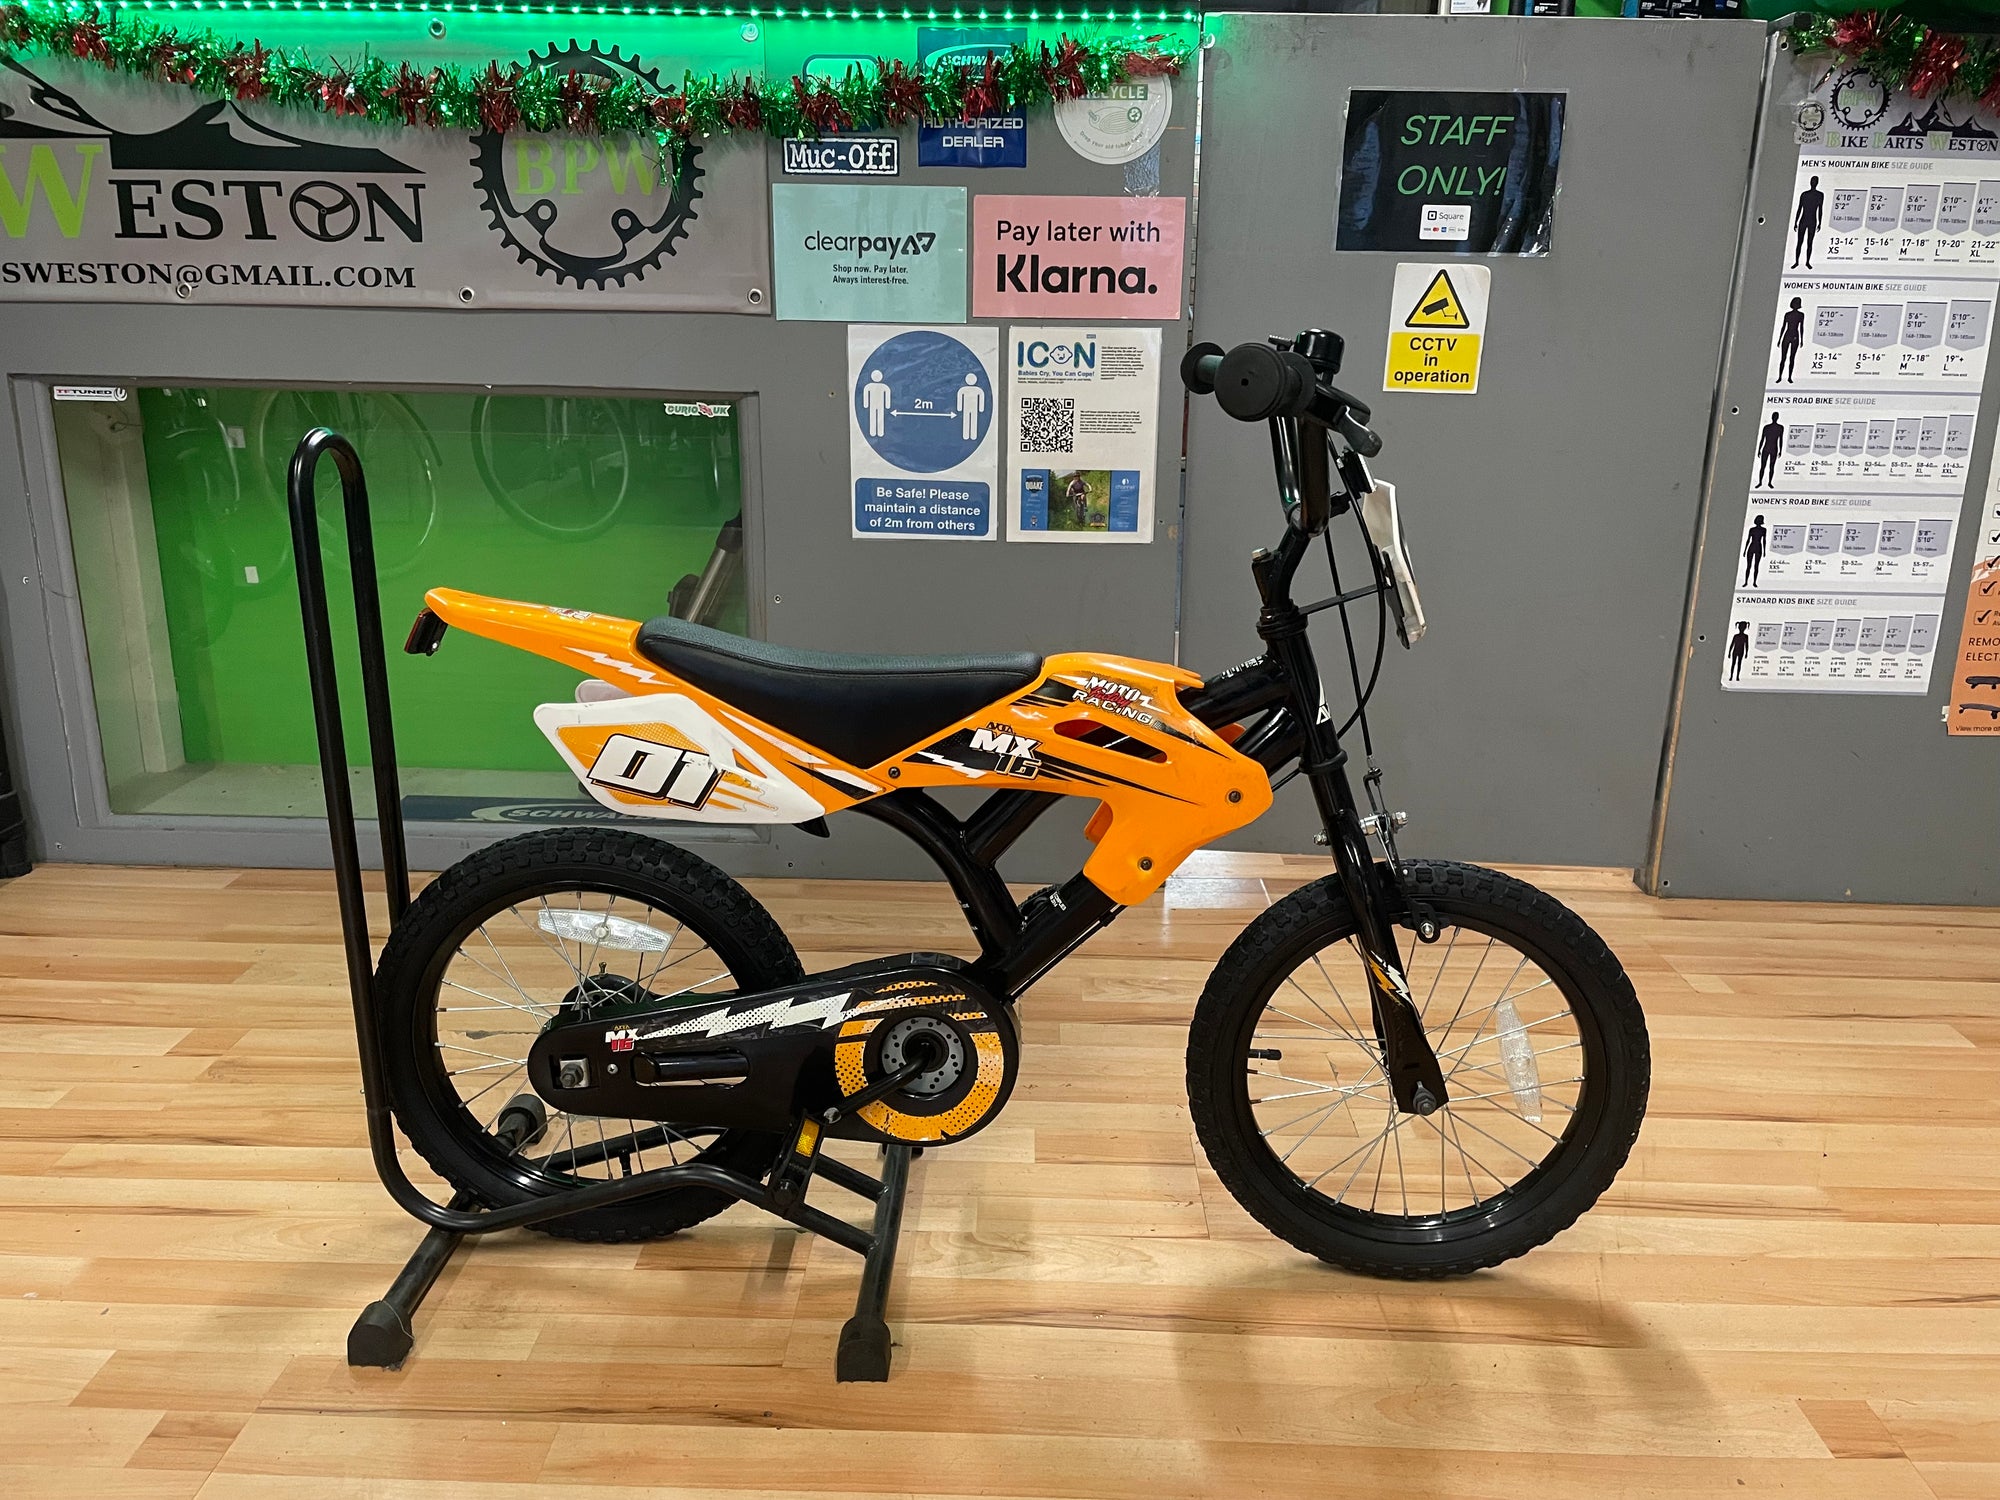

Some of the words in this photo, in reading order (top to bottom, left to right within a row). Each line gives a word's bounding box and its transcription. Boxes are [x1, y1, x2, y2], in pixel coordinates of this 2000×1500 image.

[1400, 114, 1515, 146] STAFF
[942, 136, 1005, 148] DEALER
[789, 144, 894, 170] Muc-Off
[513, 138, 659, 196] BPW
[1801, 160, 1827, 168] MEN'S
[1828, 161, 1870, 169] MOUNTAIN
[1397, 165, 1508, 196] ONLY!
[1439, 212, 1464, 221] Square
[997, 220, 1040, 246] Pay
[1047, 221, 1102, 242] later
[1108, 220, 1160, 243] with
[804, 230, 901, 260] clearpay
[1863, 247, 1869, 255] S
[1935, 248, 1940, 256] L
[1970, 249, 1981, 257] XL
[2, 262, 416, 290] SWESTON@GMAIL.COM
[832, 264, 850, 275] Shop
[852, 265, 872, 274] now.
[873, 264, 889, 276] Pay
[890, 264, 909, 274] later.
[996, 253, 1158, 295] Klarna.
[832, 275, 858, 286] Always
[859, 275, 909, 286] interest-free.
[1783, 282, 1821, 290] WOMEN'S
[1865, 283, 1884, 291] BIKE
[1409, 337, 1457, 351] CCTV
[1424, 353, 1438, 367] in
[1812, 361, 1823, 369] XS
[1855, 361, 1861, 369] S
[1899, 362, 1907, 370] M
[1943, 363, 1949, 371] L
[1394, 369, 1470, 385] operation
[914, 398, 933, 410] 2m
[1767, 396, 1791, 404] MEN'S
[1792, 397, 1814, 405] ROAD
[1815, 397, 1833, 405] BIKE
[876, 487, 892, 499] Be
[896, 487, 926, 500] Safe!
[929, 488, 969, 501] Please
[864, 502, 916, 514] maintain
[919, 505, 927, 514] a
[929, 503, 981, 516] distance
[869, 516, 882, 527] of
[884, 517, 902, 528] 2m
[906, 517, 934, 529] from
[937, 518, 975, 531] others
[1966, 652, 2000, 662] ELECT
[1086, 676, 1141, 701] MOTO
[1072, 689, 1153, 724] RACING
[968, 728, 1043, 759] MX
[586, 733, 724, 811] 01
[994, 754, 1042, 780] 16
[605, 1028, 639, 1043] MX
[611, 1038, 635, 1053] 16
